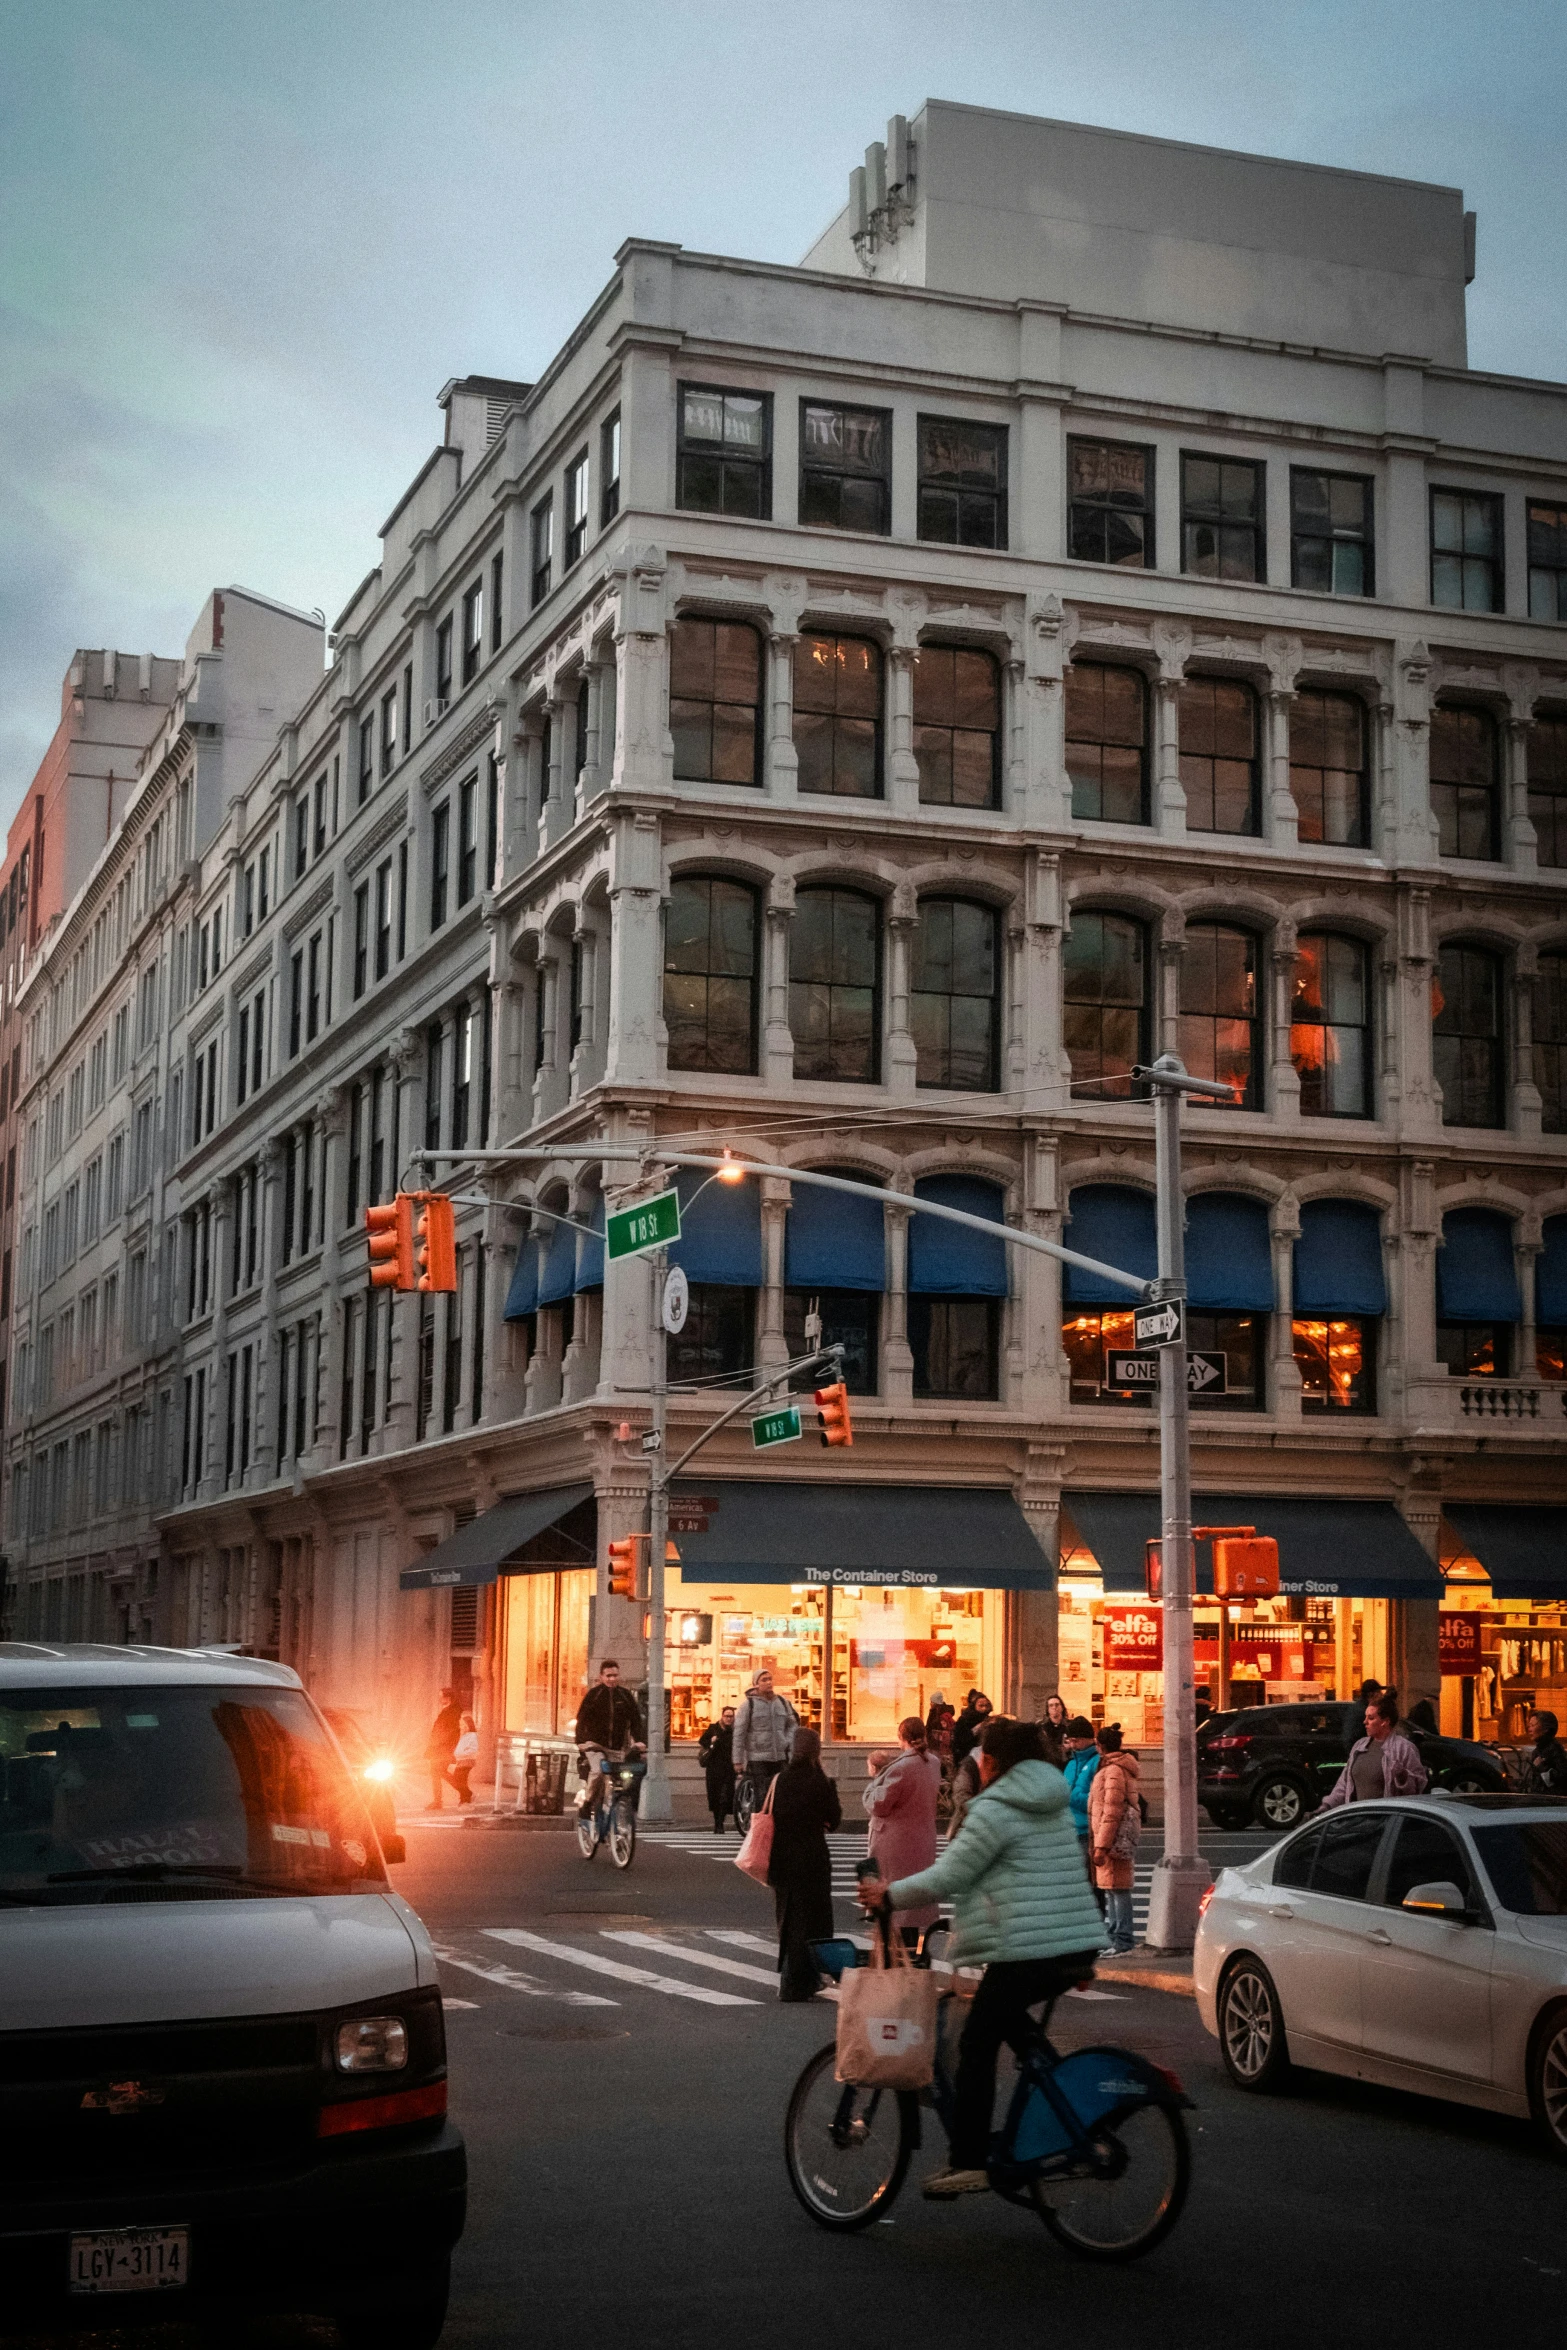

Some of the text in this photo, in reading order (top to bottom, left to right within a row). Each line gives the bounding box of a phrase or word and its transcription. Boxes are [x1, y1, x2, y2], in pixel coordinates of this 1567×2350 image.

[629, 1213, 658, 1244] W 18 St
[1141, 1314, 1174, 1336] ONE WAY
[1125, 1362, 1208, 1381] ONE AY
[669, 1502, 704, 1512] Americas
[678, 1520, 699, 1531] 6 Av
[805, 1567, 938, 1583] The Container Store
[1305, 1580, 1339, 1593] Store
[1110, 1614, 1157, 1633] elfa
[1110, 1634, 1157, 1645] 30% Off
[1457, 1638, 1475, 1649] Off
[87, 1826, 213, 1856] HALAL
[99, 2236, 126, 2246] NEW
